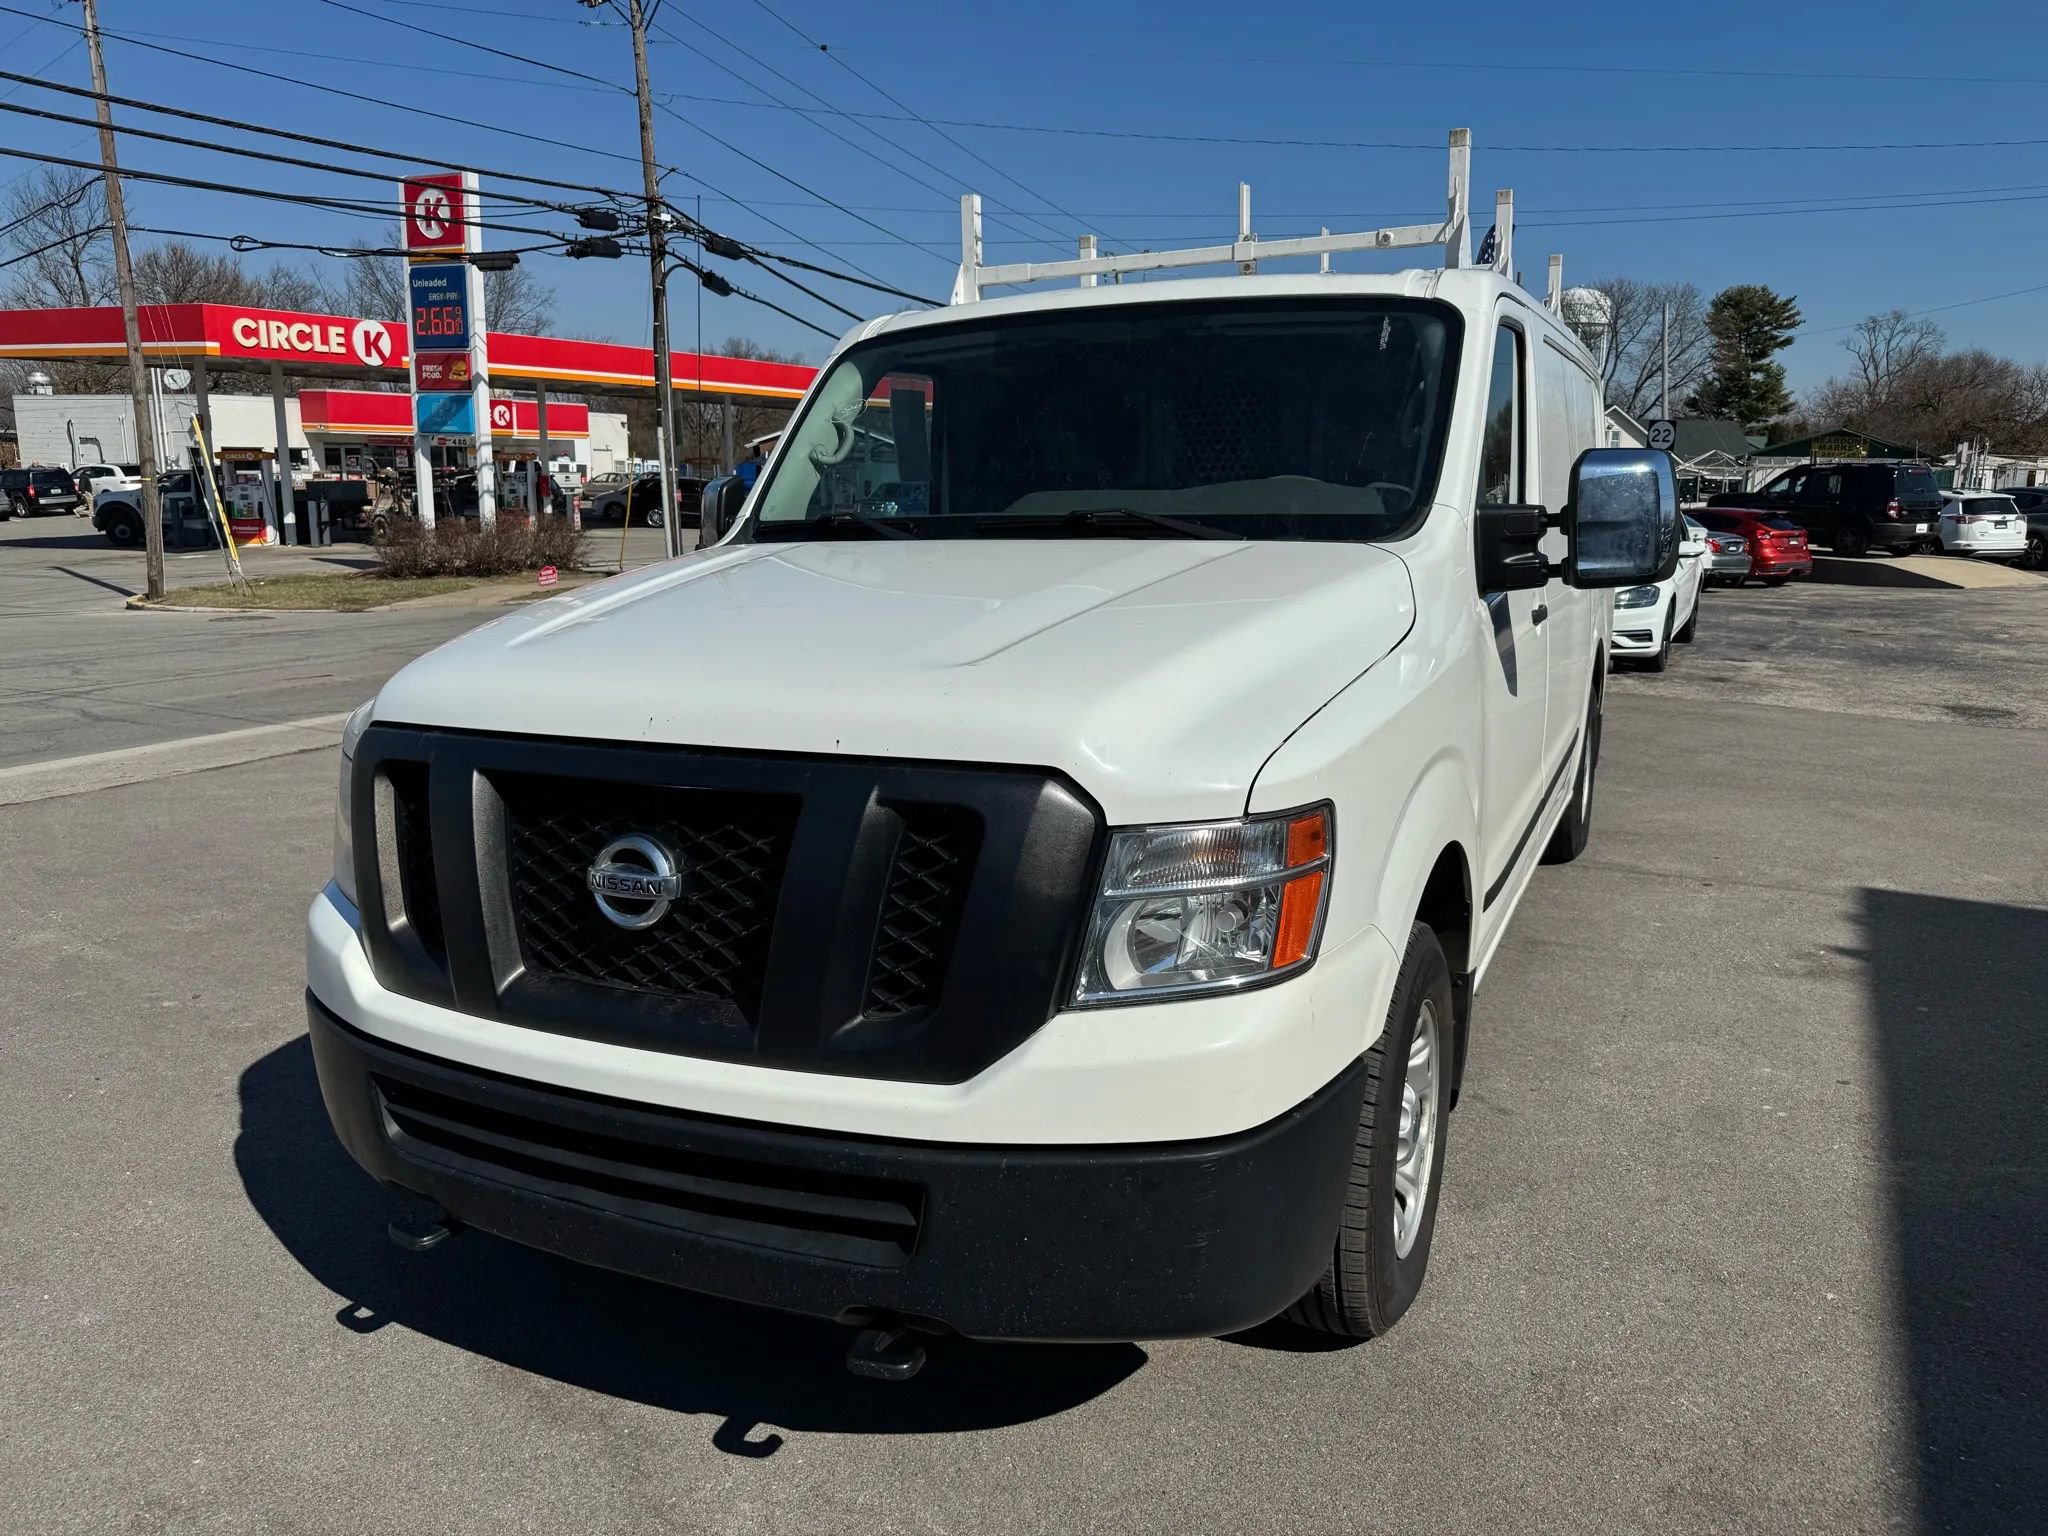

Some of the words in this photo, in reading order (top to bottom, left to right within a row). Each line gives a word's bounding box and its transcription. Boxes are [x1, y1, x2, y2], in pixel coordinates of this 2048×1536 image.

[412, 278, 447, 288] Unleaded
[428, 292, 444, 301] EASY
[446, 291, 458, 300] PAY
[232, 317, 347, 355] CIRCLE
[422, 364, 443, 372] FRESH
[1651, 428, 1671, 443] 22
[591, 873, 663, 895] NISSAN
